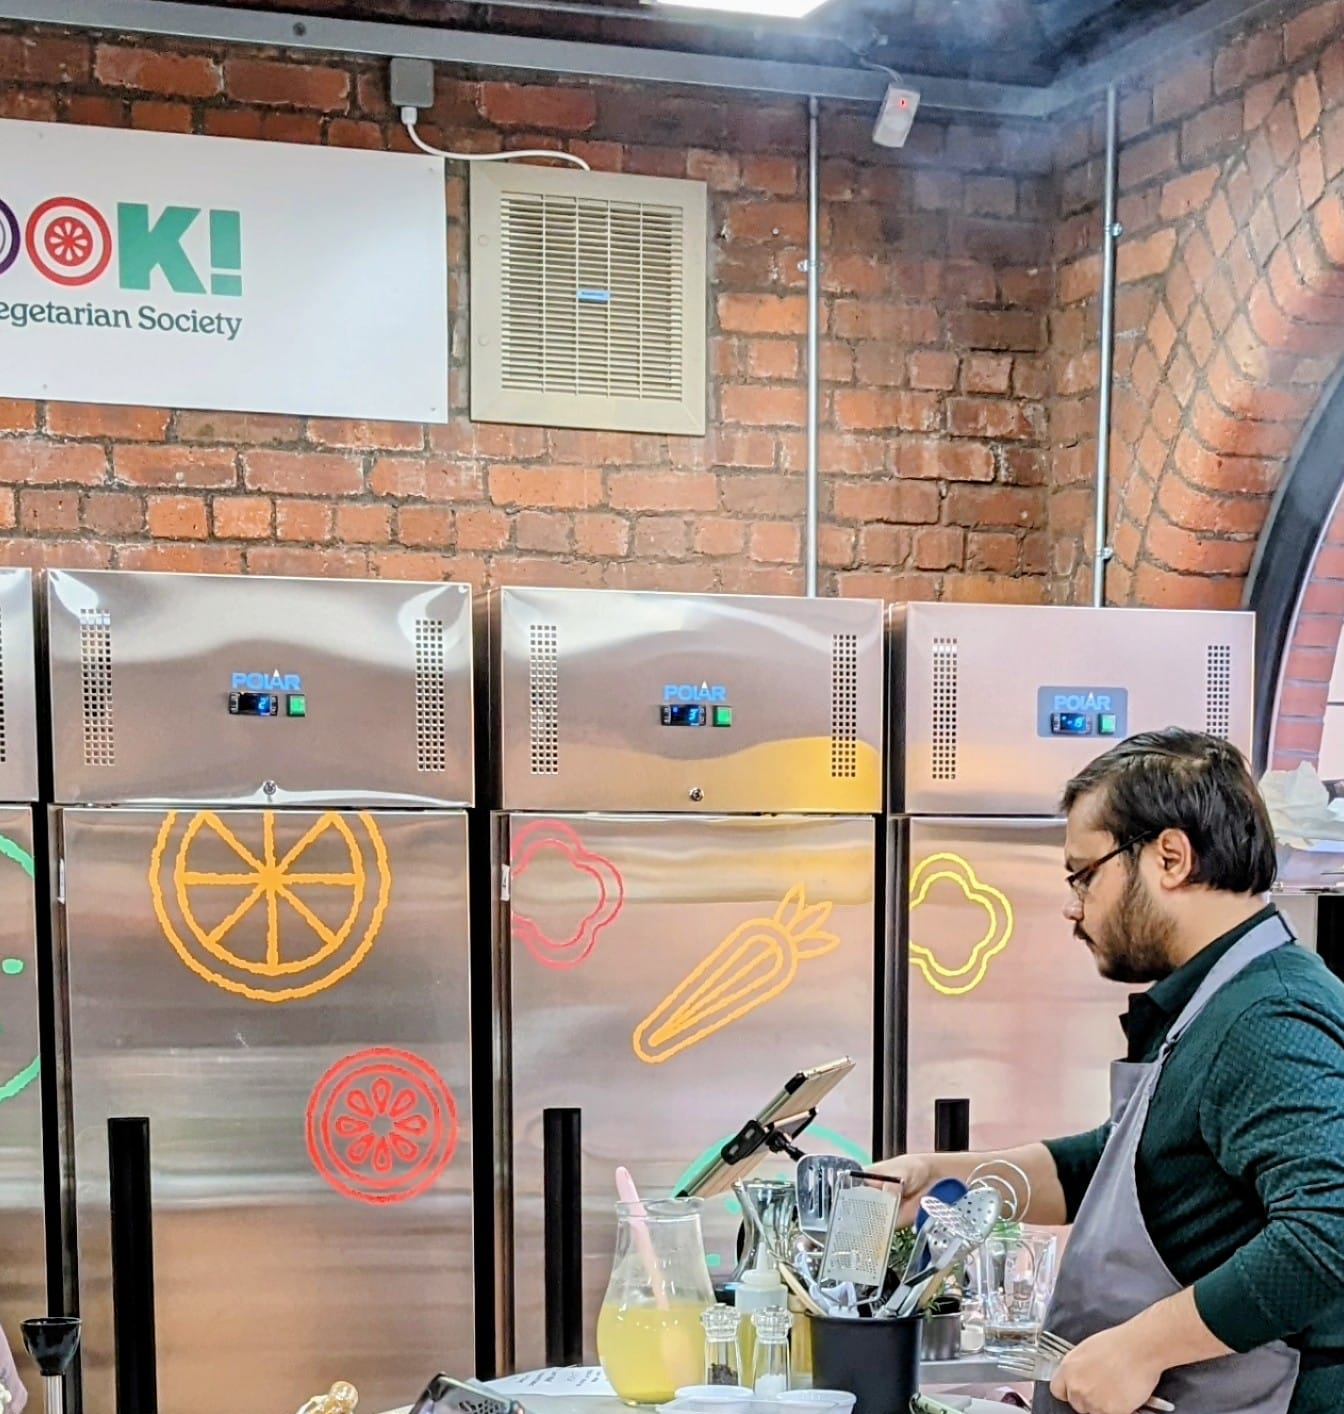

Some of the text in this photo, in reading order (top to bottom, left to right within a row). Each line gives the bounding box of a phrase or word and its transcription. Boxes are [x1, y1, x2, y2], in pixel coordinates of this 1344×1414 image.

[138, 305, 243, 341] Society
[231, 668, 301, 690] POLAR
[662, 680, 727, 701] POLAR
[1053, 691, 1111, 711] POLAR
